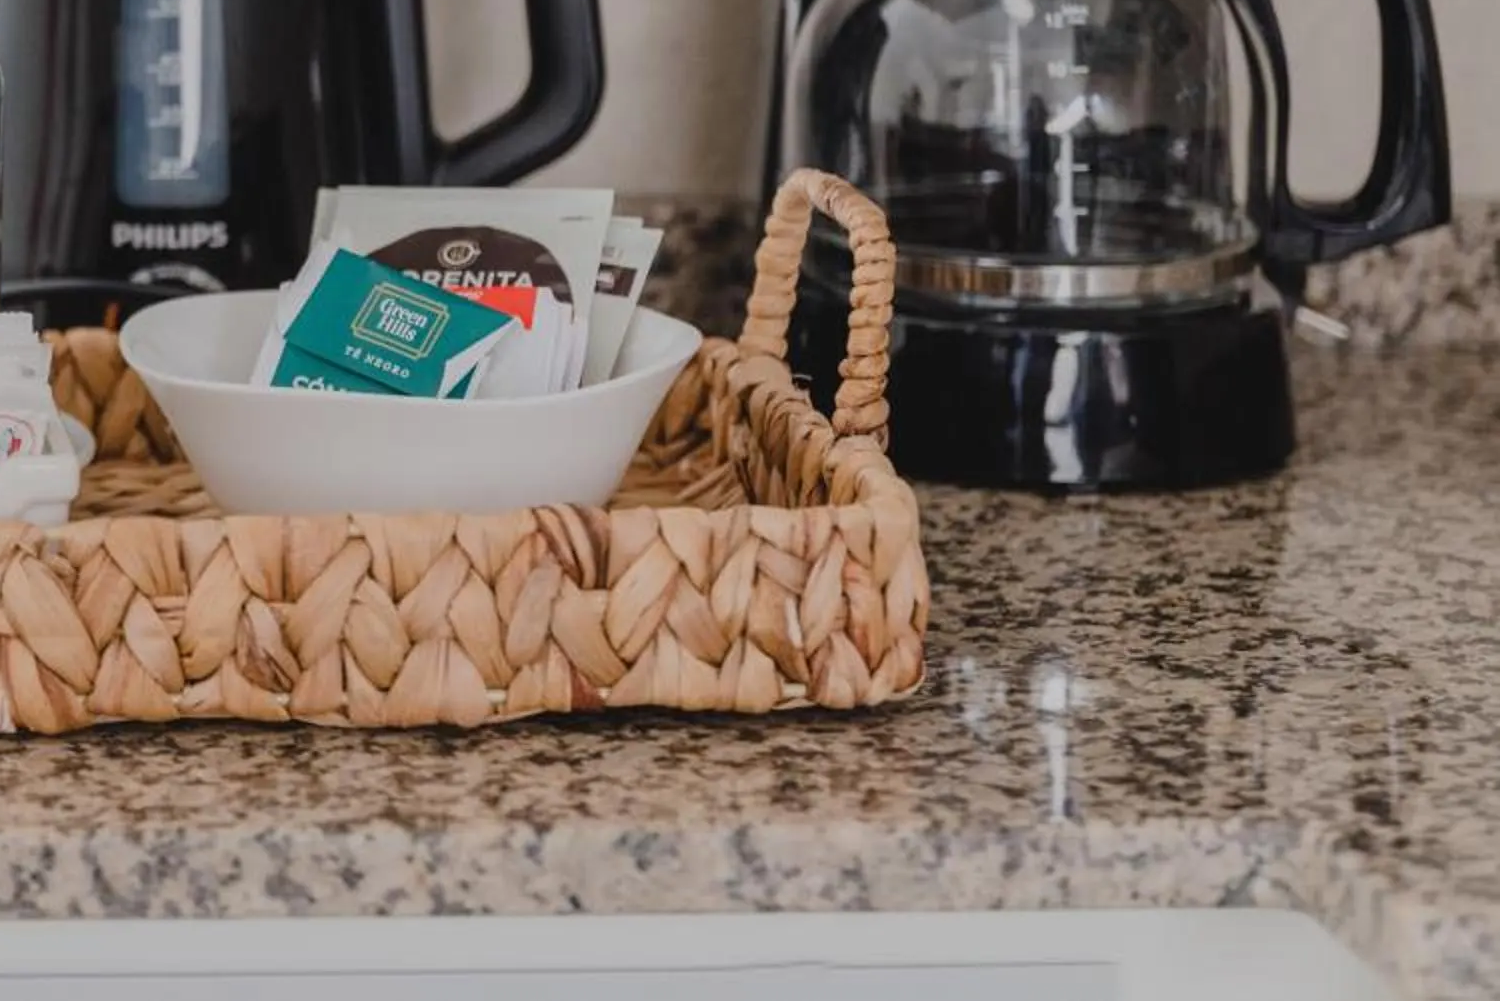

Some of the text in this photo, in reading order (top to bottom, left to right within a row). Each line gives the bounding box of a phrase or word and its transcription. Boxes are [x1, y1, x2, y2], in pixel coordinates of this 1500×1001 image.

[112, 221, 229, 249] PHILIPS
[377, 313, 417, 342] Hills
[379, 298, 428, 329] Green
[363, 353, 410, 379] NEGRO
